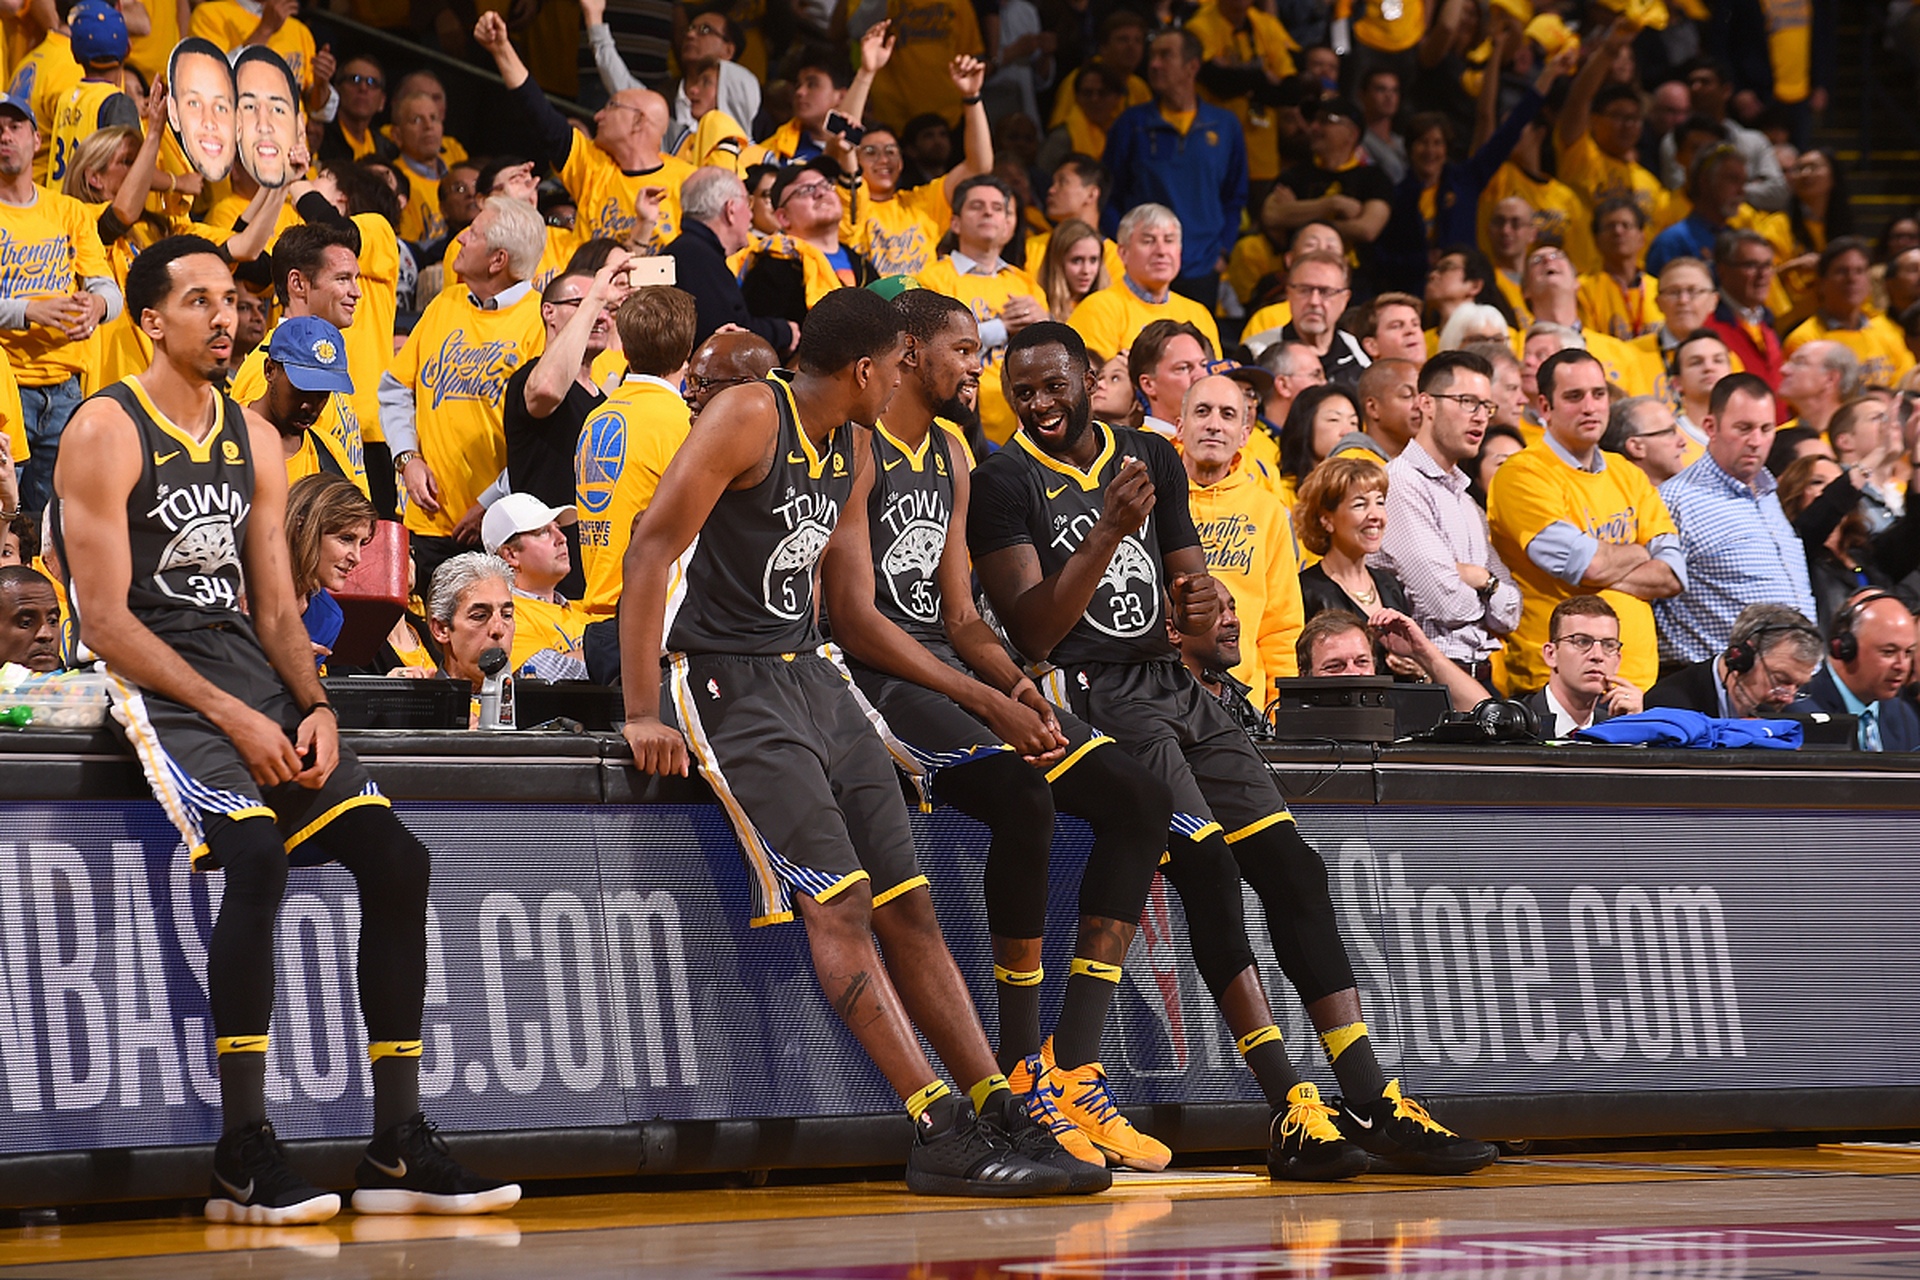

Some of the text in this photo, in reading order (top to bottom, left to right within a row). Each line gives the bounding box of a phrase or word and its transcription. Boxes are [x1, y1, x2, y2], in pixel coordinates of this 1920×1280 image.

[146, 482, 252, 532] TOWN
[880, 489, 950, 536] TOWN
[1195, 513, 1249, 549] ength
[1204, 539, 1255, 576] mbers
[186, 575, 237, 608] 34
[782, 576, 797, 612] 5
[909, 580, 934, 614] 35
[1109, 592, 1146, 631] 23
